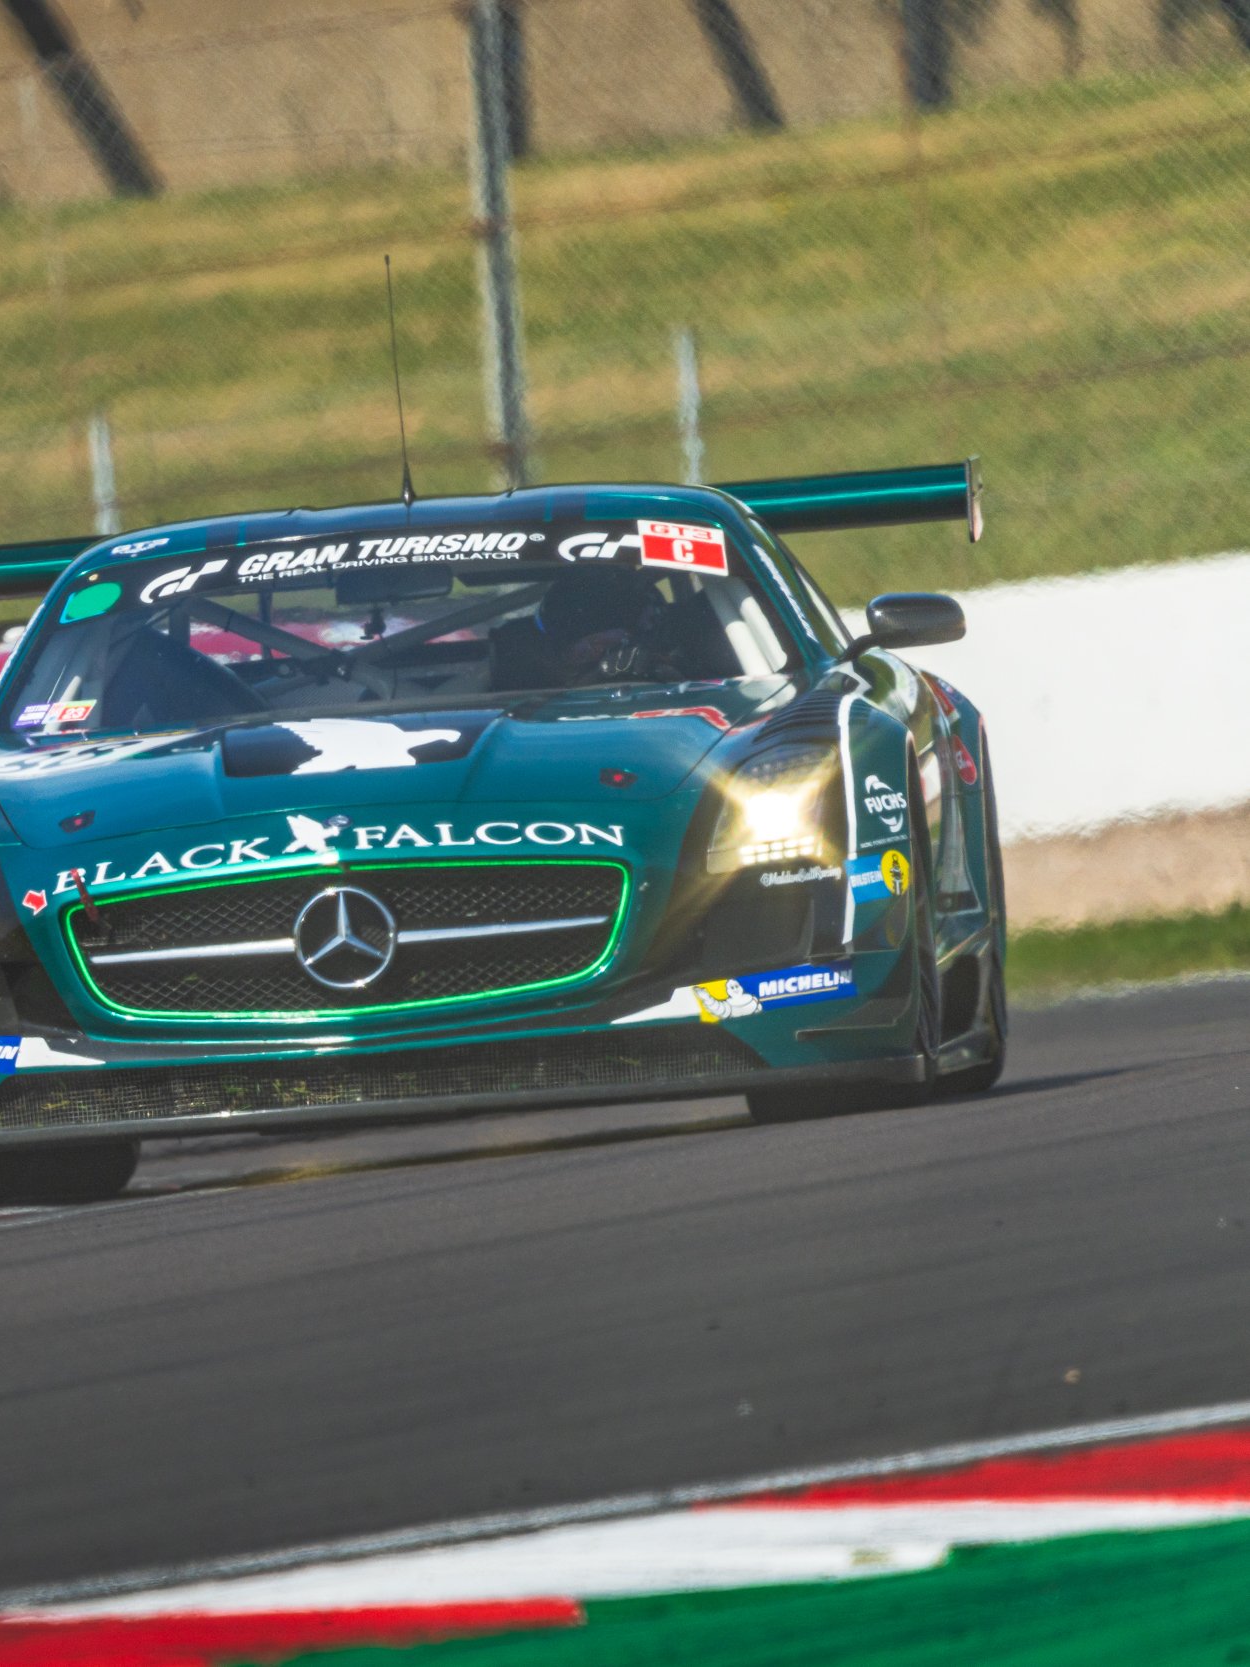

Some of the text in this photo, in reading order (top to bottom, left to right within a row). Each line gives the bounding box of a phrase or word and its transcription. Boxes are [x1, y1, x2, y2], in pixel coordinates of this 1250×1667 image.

[650, 523, 713, 541] GT3
[237, 543, 349, 576] GRAN
[672, 539, 695, 563] C
[238, 551, 519, 584] THE REAL DRIVING SIMULATOR
[864, 792, 908, 814] FUCHS
[52, 821, 624, 895] BLACK FALCON
[758, 969, 853, 998] MICHELIN
